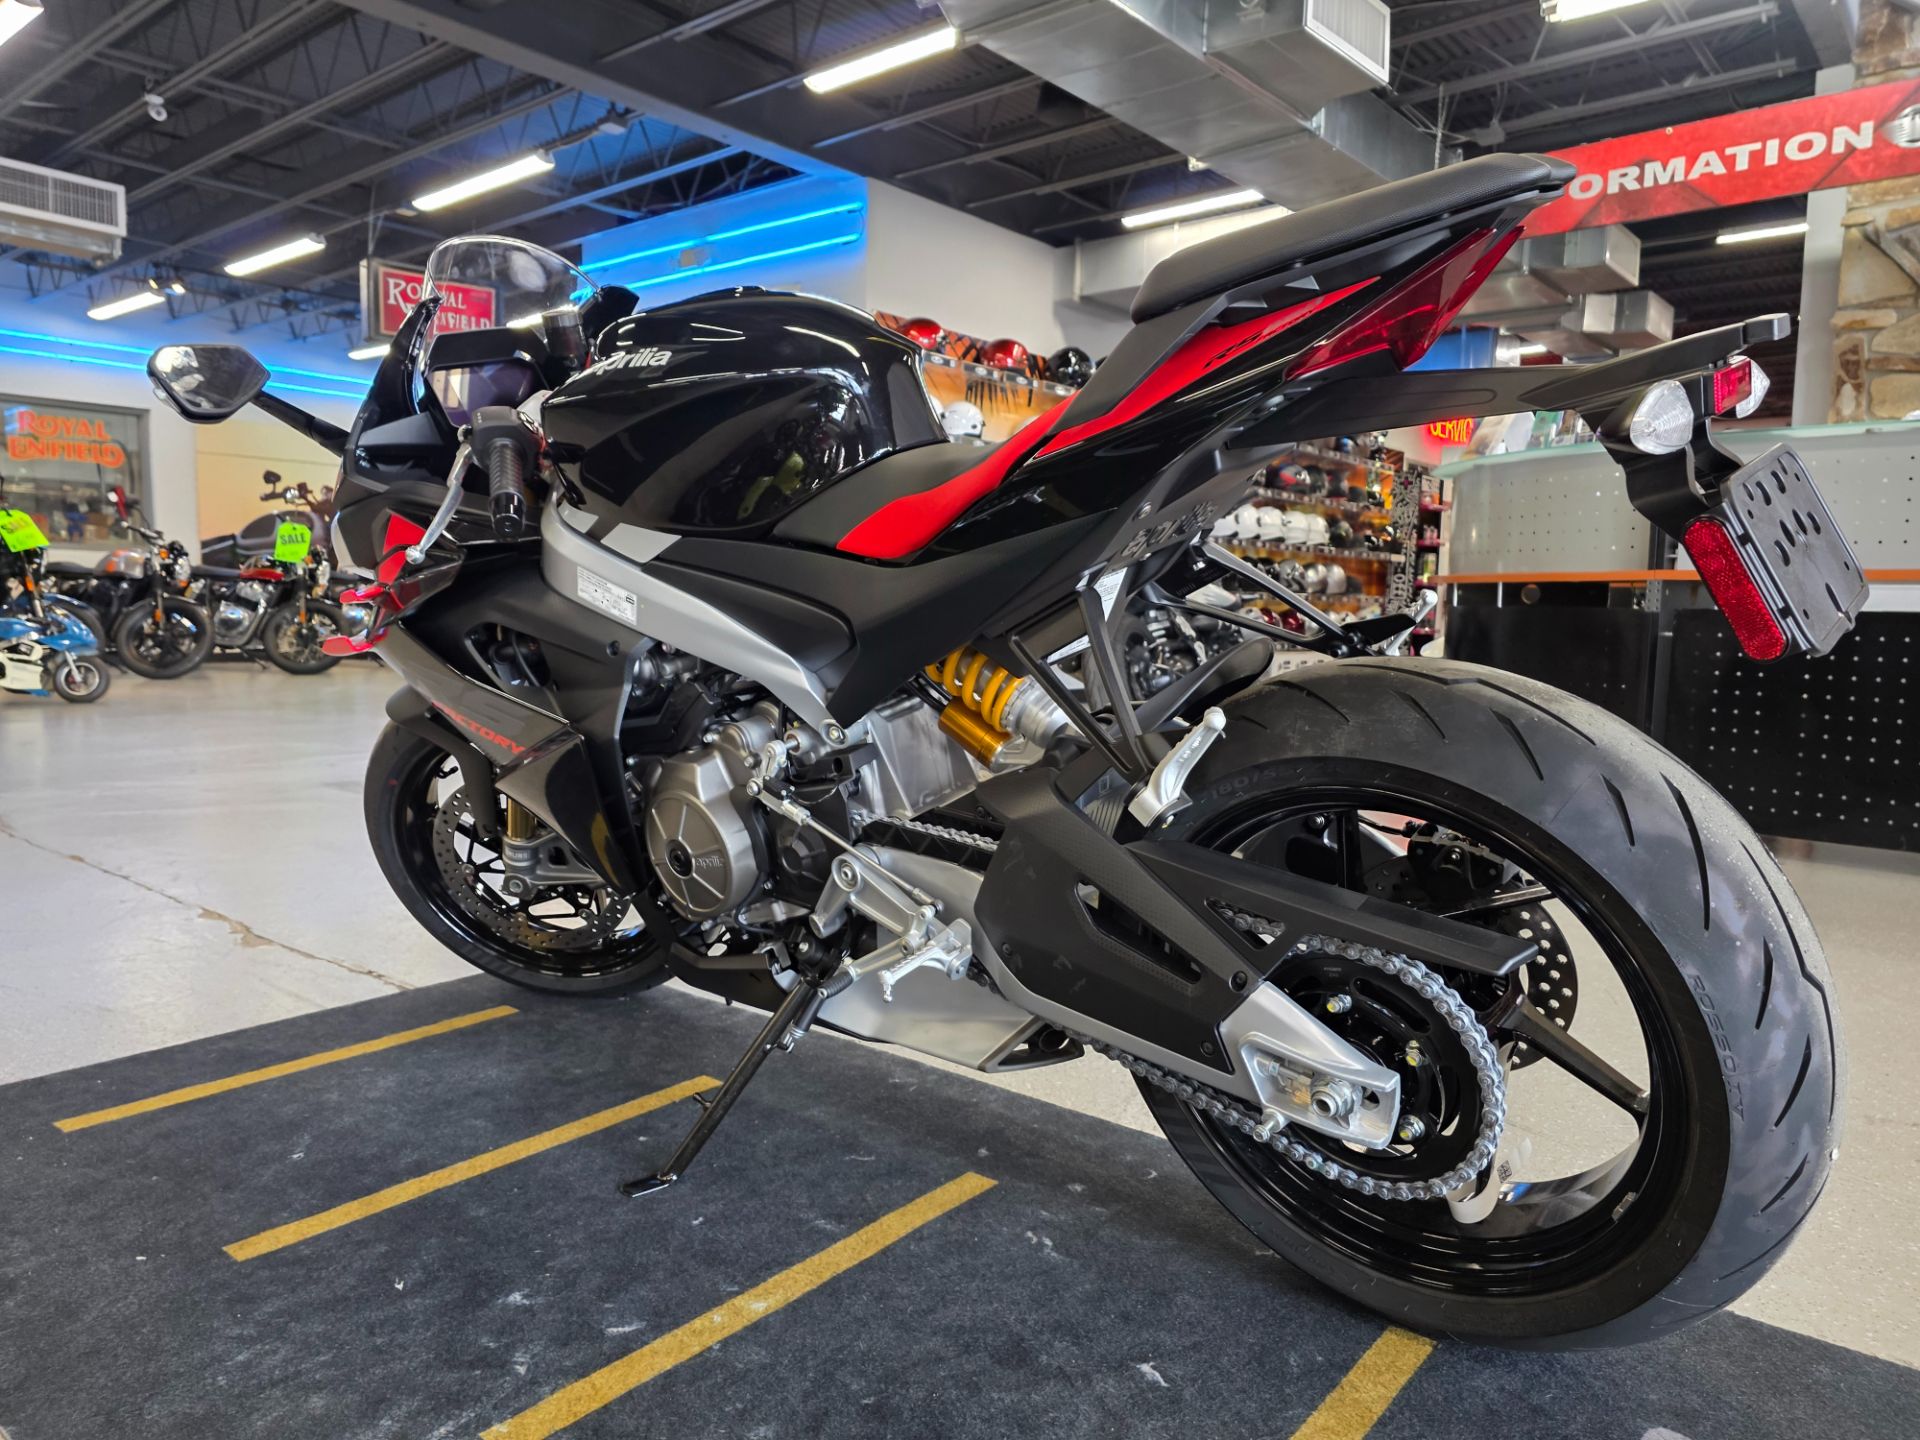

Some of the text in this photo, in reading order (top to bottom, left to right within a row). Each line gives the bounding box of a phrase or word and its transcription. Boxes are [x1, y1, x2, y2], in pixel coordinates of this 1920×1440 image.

[1568, 121, 1875, 200] ORMATION
[387, 278, 467, 314] ROAL
[17, 410, 112, 442] ROYAL
[8, 435, 125, 468] ENFIELD
[280, 533, 306, 545] SALE
[1688, 974, 1737, 1074] ROSSO
